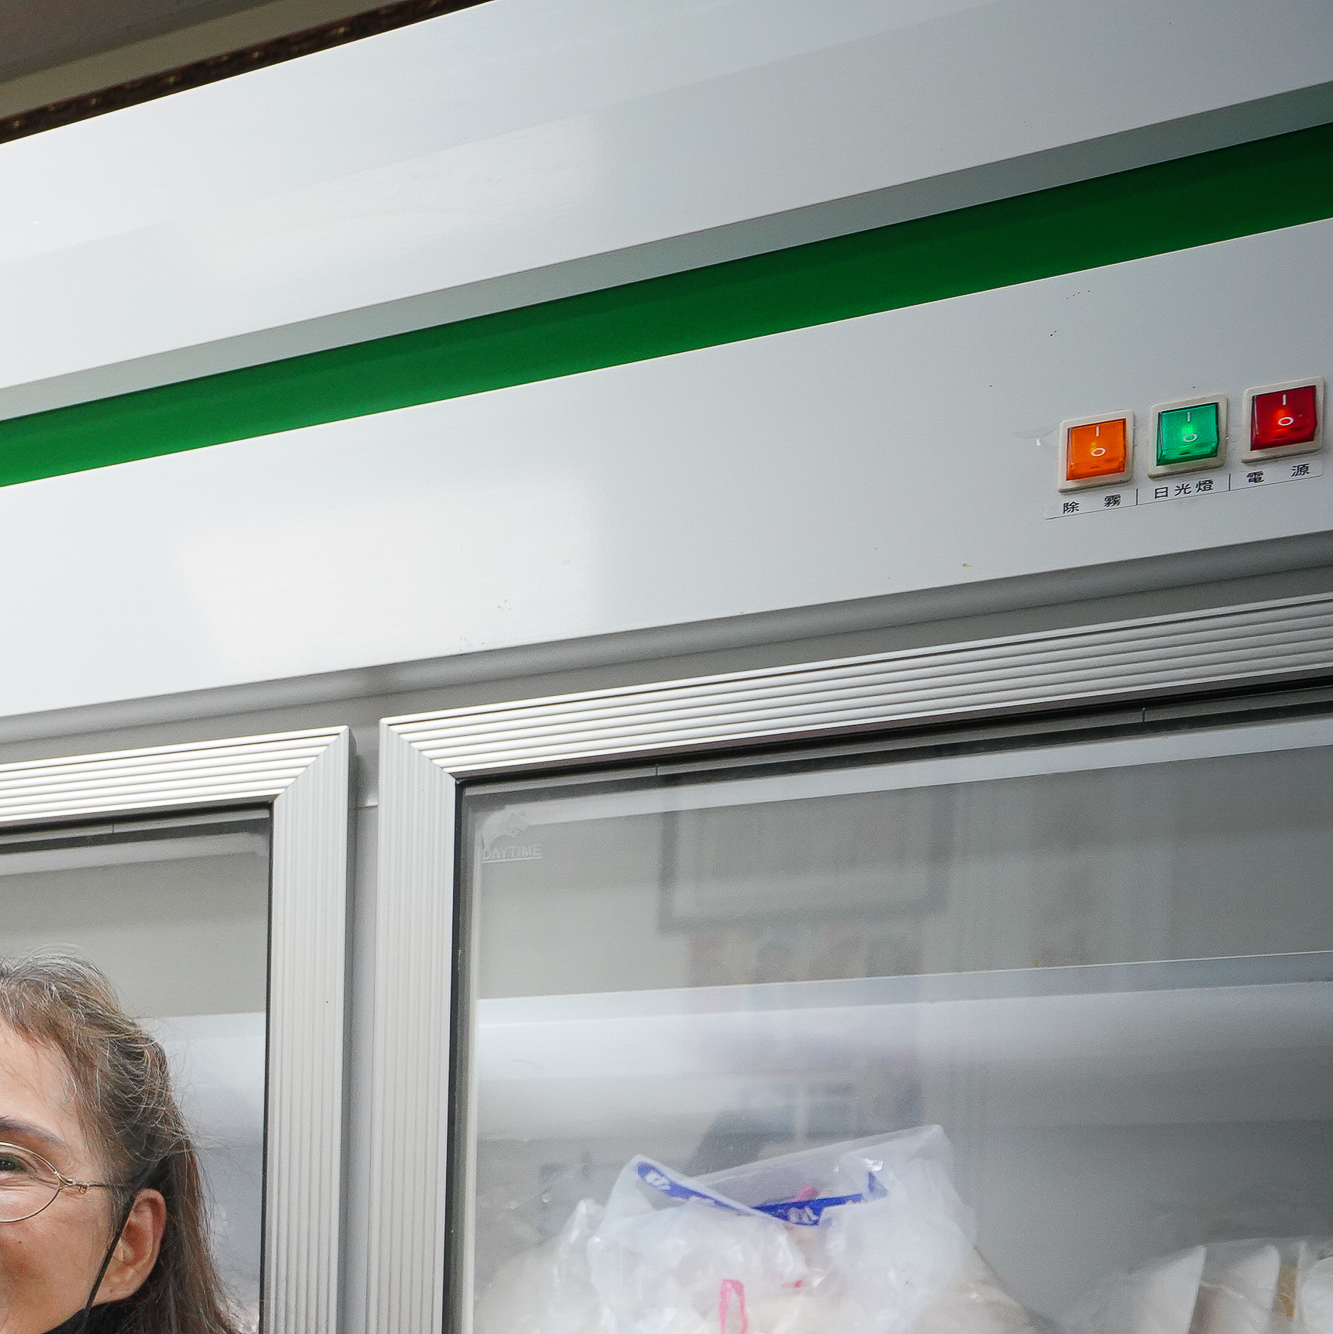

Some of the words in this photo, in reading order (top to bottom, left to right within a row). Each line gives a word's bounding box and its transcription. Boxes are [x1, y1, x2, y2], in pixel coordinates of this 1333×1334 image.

[1246, 462, 1310, 484] 電源
[1154, 478, 1214, 500] 日光燈
[1062, 493, 1121, 515] 除霧
